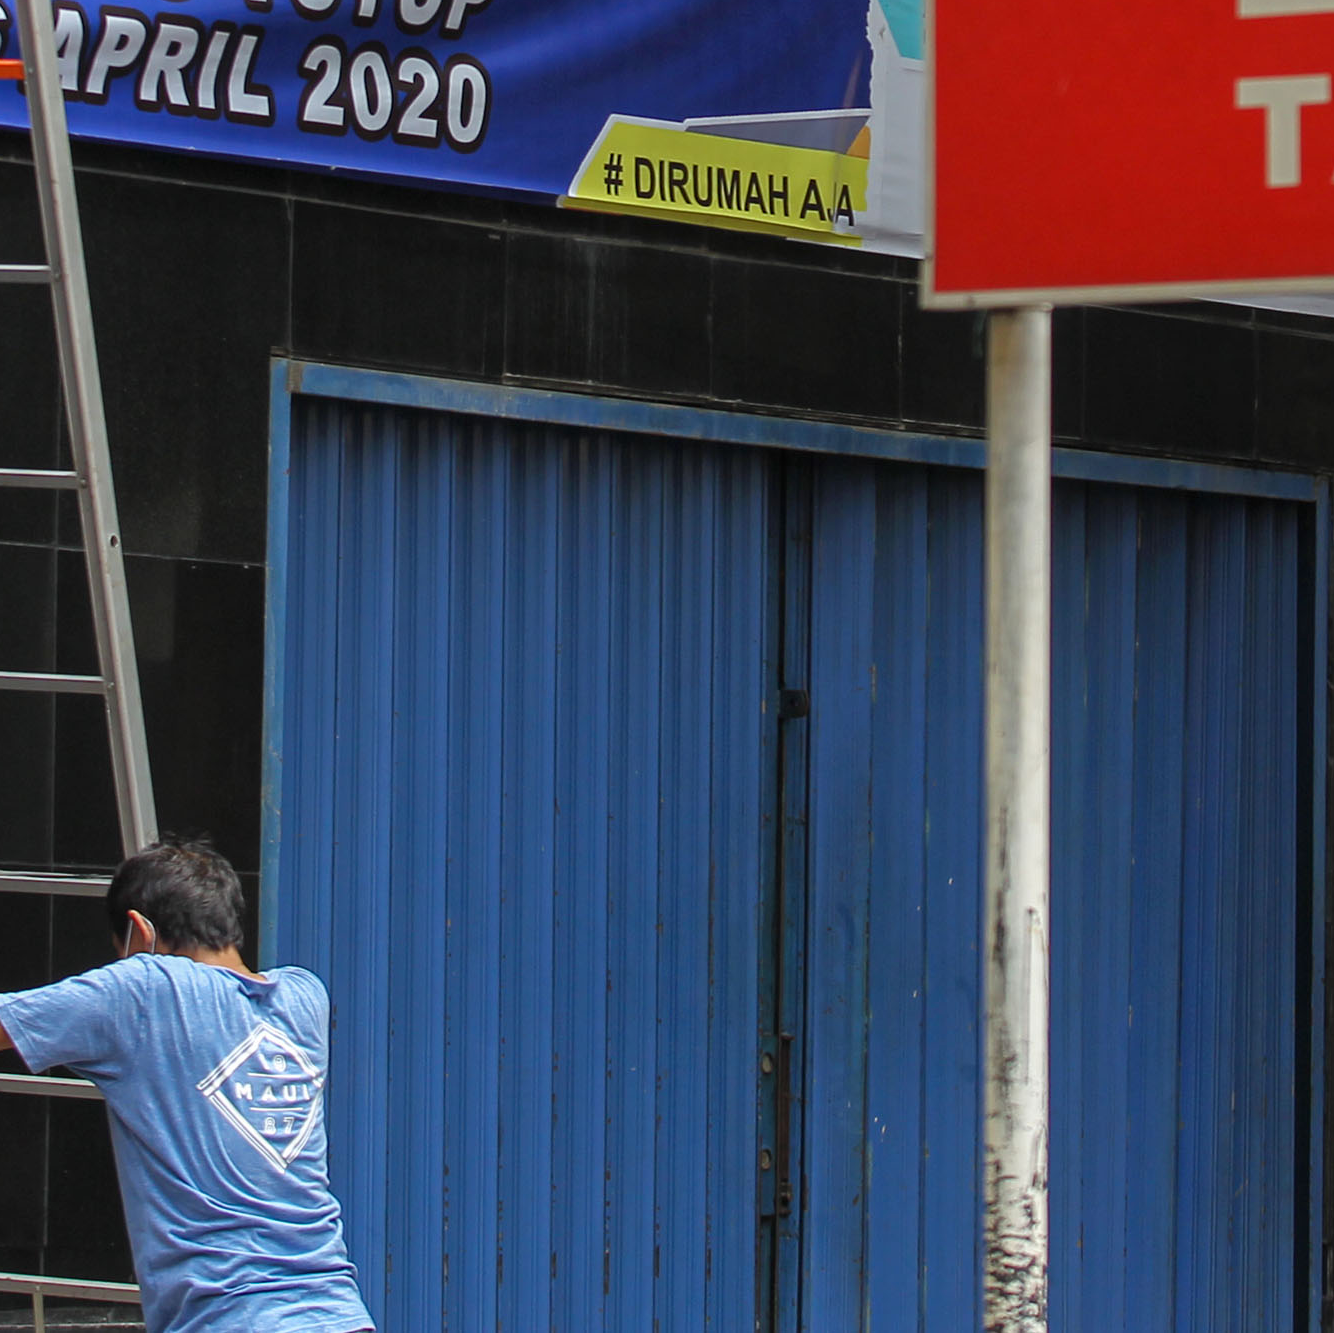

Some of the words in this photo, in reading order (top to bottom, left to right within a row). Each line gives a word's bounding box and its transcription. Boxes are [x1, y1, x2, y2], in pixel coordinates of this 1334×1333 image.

[301, 44, 487, 145] 2020
[634, 156, 790, 218] DIRUMAH
[234, 1081, 311, 1102] MAUI
